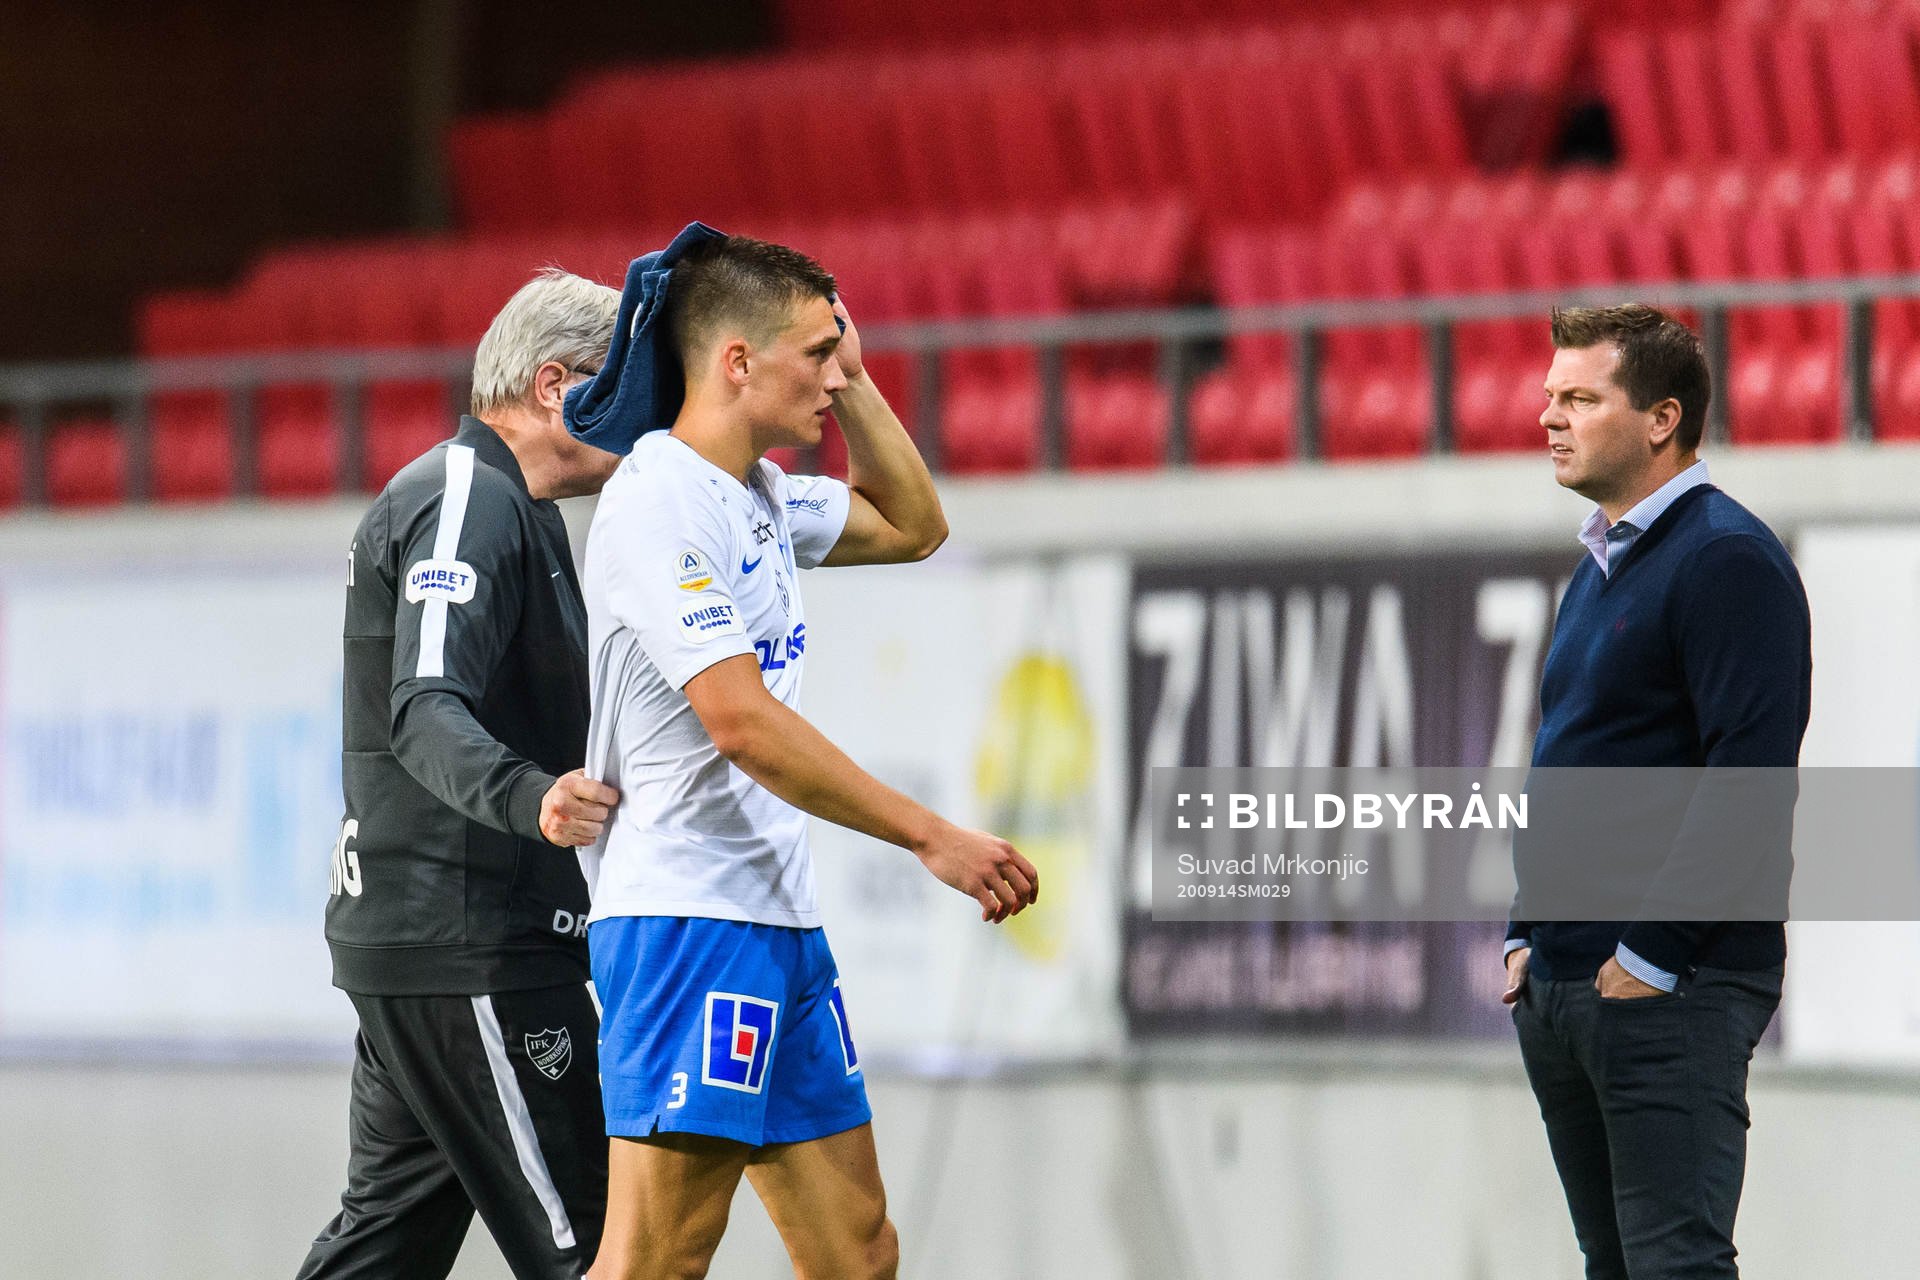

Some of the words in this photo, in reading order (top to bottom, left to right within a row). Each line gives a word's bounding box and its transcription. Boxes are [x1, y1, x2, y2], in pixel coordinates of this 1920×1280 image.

[412, 570, 469, 586] UNIBET
[682, 605, 734, 628] UNIBET
[530, 1038, 550, 1050] IFK
[666, 1071, 689, 1110] 3
